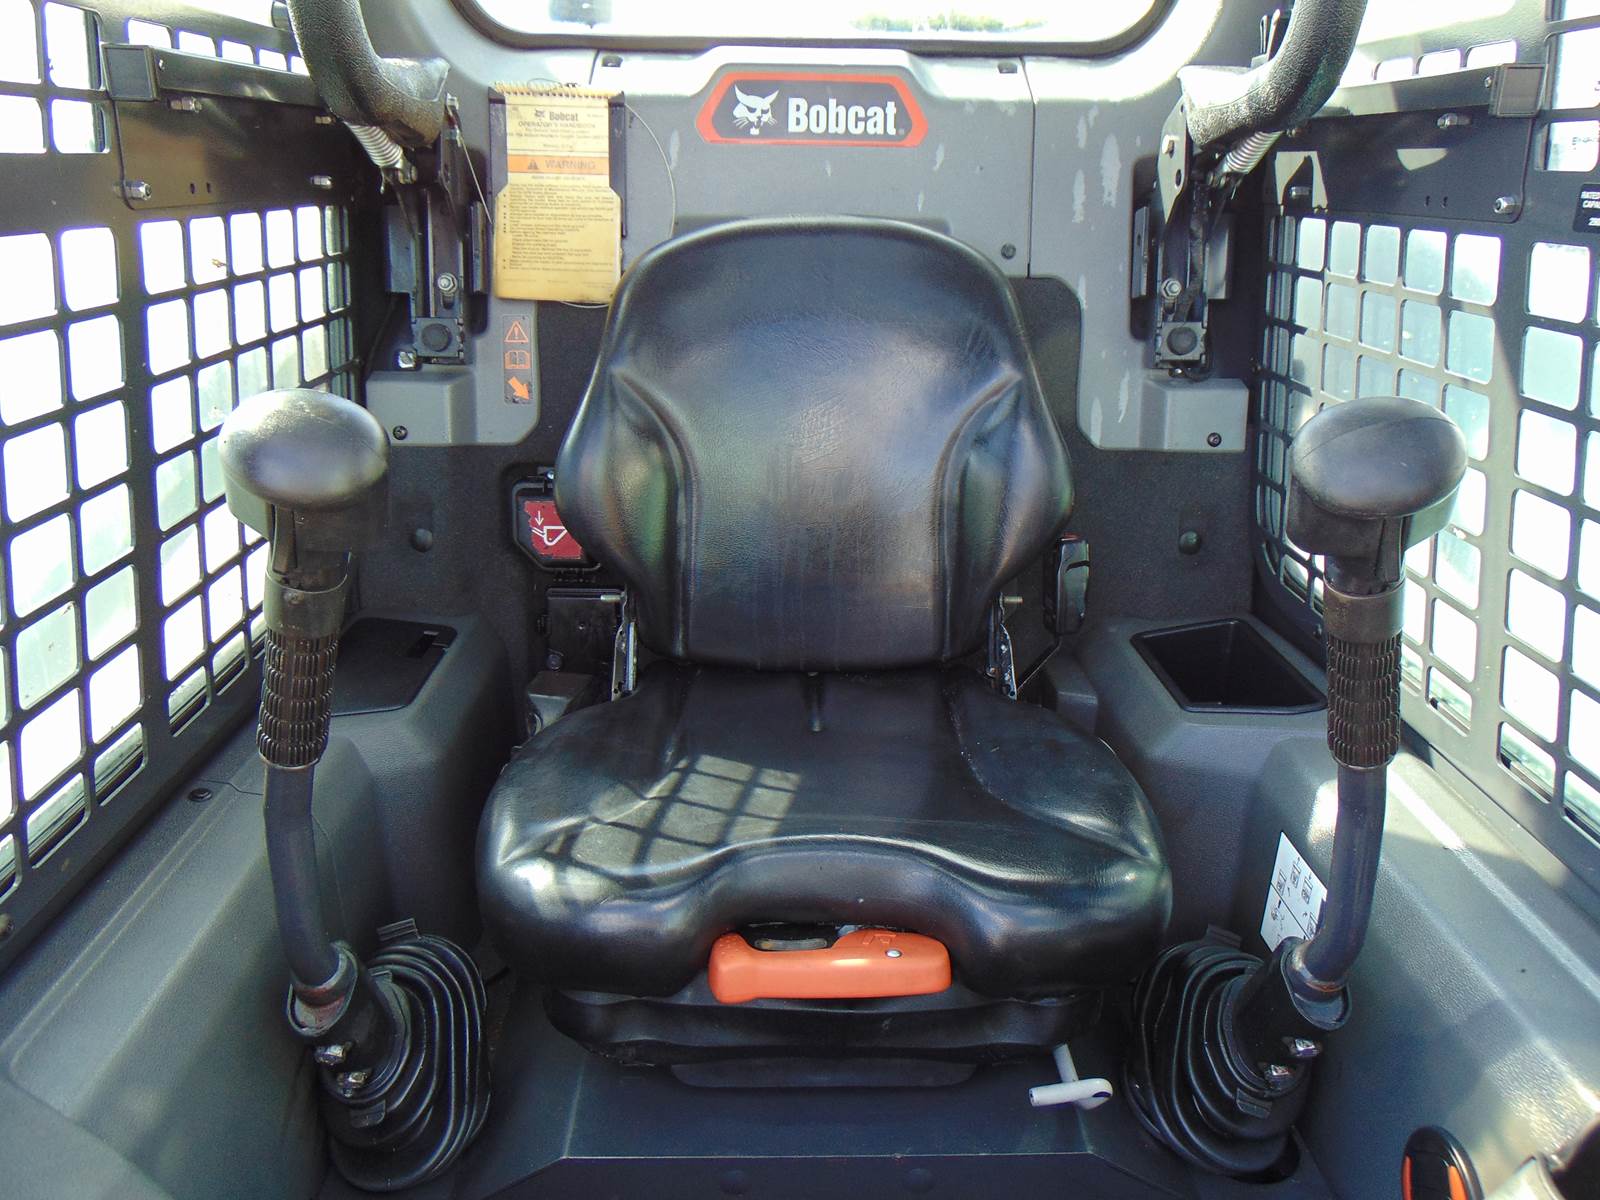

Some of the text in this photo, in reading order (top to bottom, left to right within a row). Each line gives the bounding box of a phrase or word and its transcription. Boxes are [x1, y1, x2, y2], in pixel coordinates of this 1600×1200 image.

[549, 111, 579, 121] Bobcat
[788, 97, 897, 136] Bobcat
[544, 159, 596, 170] WARNING
